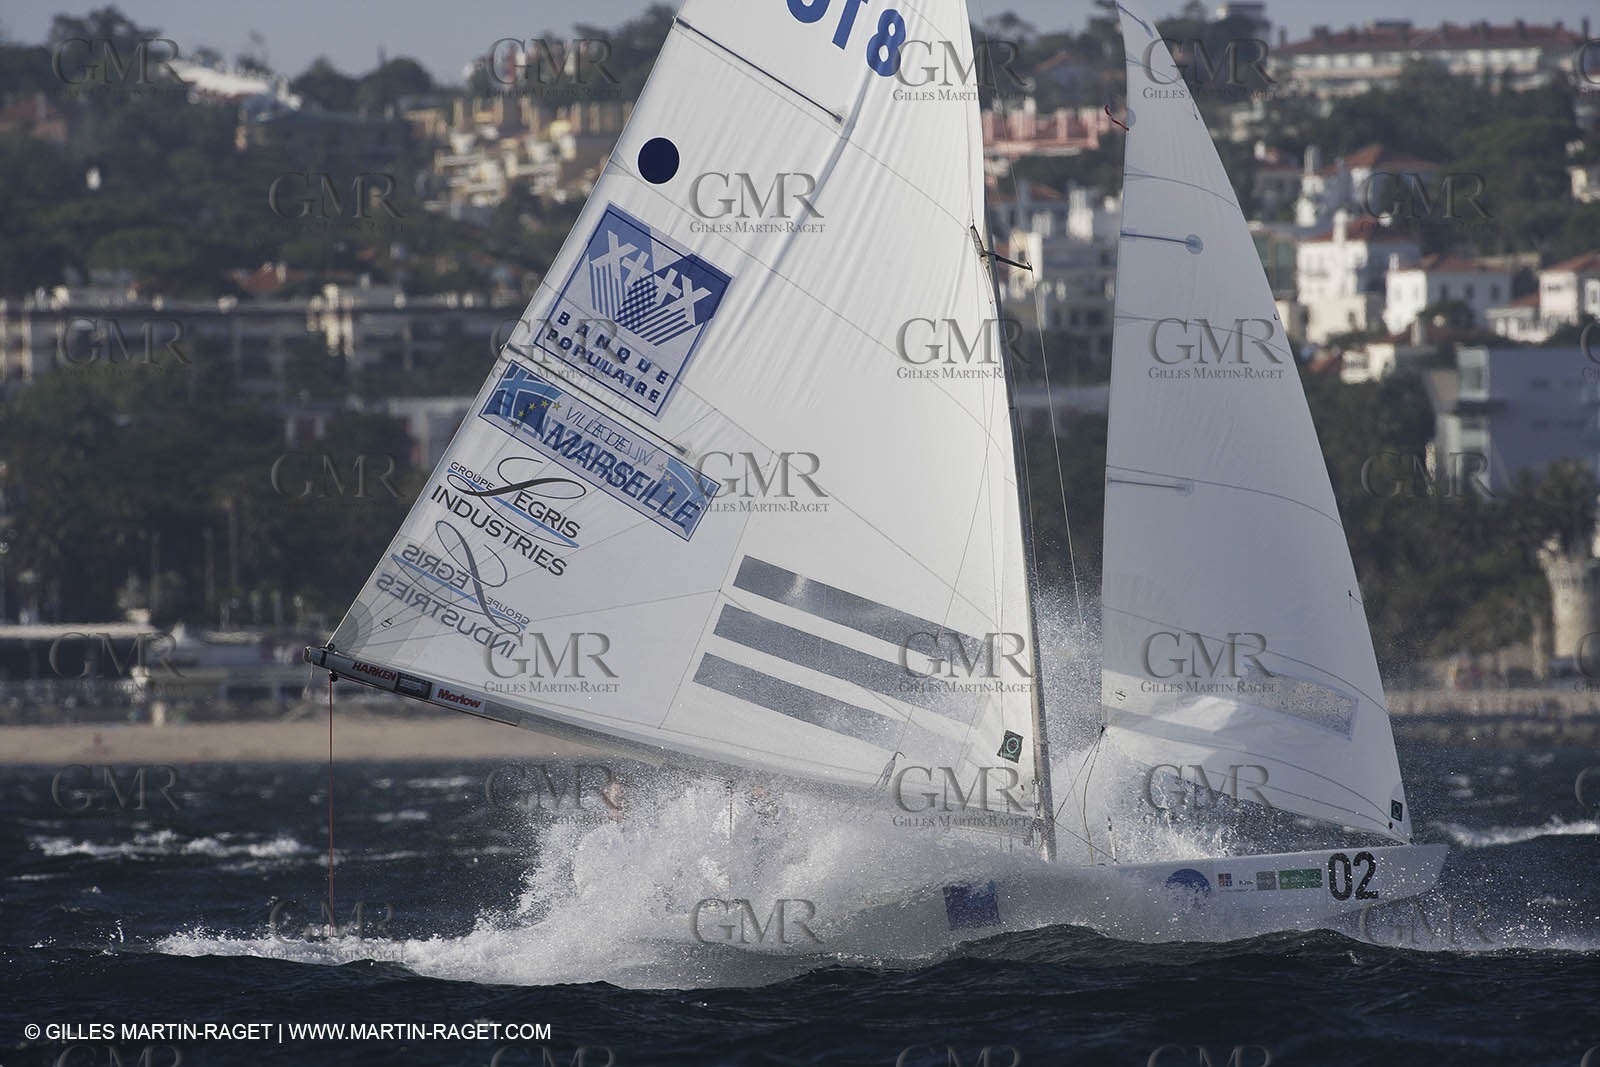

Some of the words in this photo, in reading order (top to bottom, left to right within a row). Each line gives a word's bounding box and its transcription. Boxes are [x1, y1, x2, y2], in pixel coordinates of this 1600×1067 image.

[545, 328, 661, 404] POPULAIRE
[557, 311, 669, 385] BANQUE
[449, 461, 495, 490] GROUPE
[542, 424, 700, 529] MARSEILLE
[431, 485, 567, 576] INDUSTRIES
[352, 662, 396, 681] HARKEN
[437, 688, 481, 708] Marlow
[1328, 851, 1379, 901] 02
